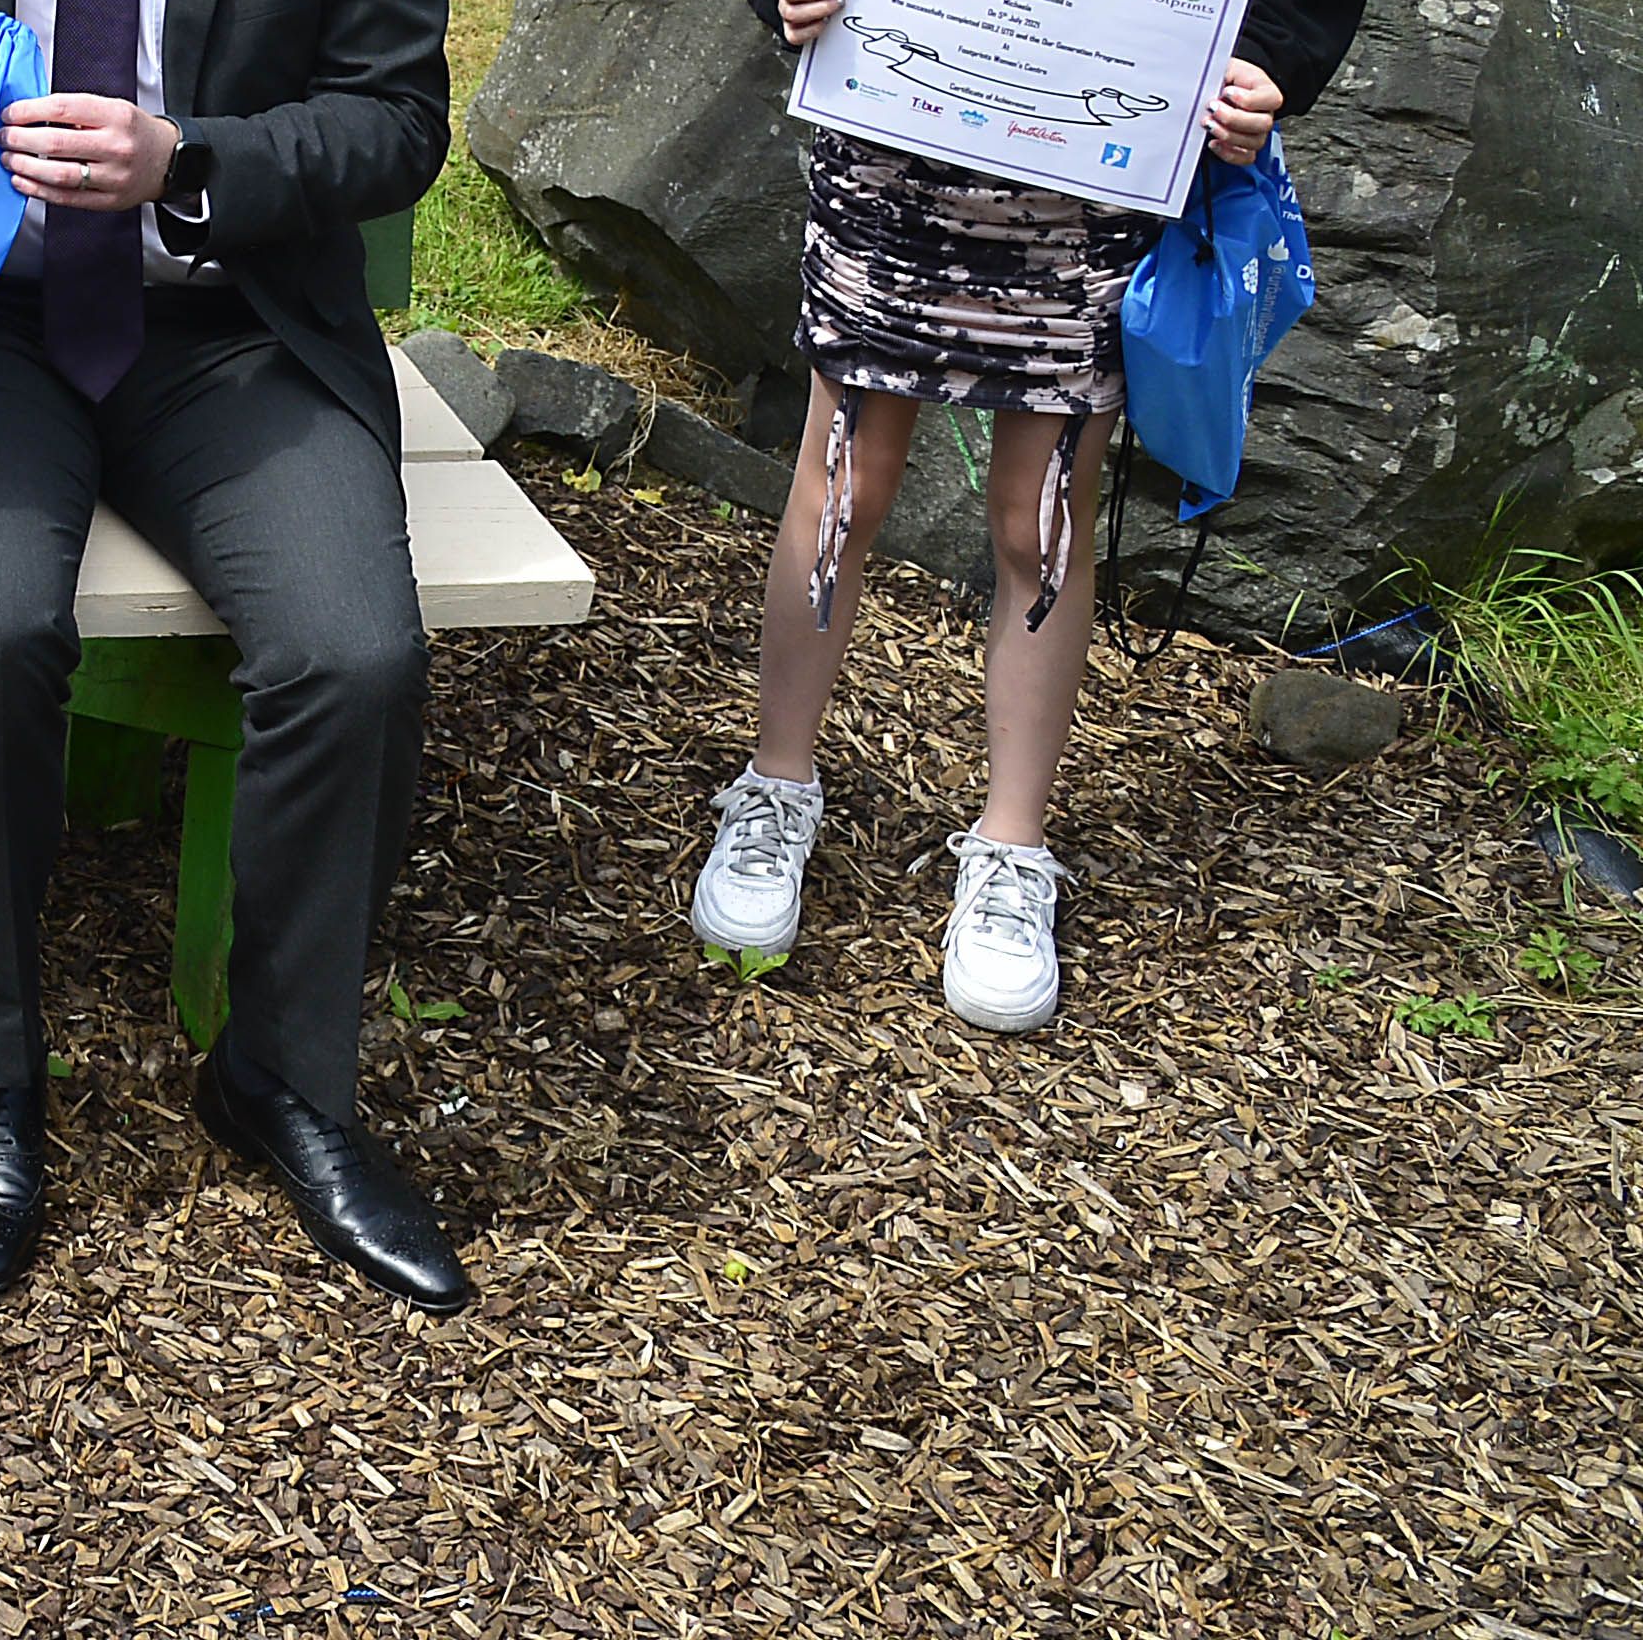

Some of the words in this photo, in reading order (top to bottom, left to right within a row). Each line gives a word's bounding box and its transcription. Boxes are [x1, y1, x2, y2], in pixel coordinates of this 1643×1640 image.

[906, 2, 945, 18] successfully
[946, 14, 980, 27] completed
[1056, 41, 1093, 56] Generation
[1095, 51, 1135, 67] Programme
[958, 45, 991, 61] Footprints
[912, 96, 944, 114] T:buc
[949, 82, 984, 98] Certificate
[994, 94, 1036, 111] Achievement
